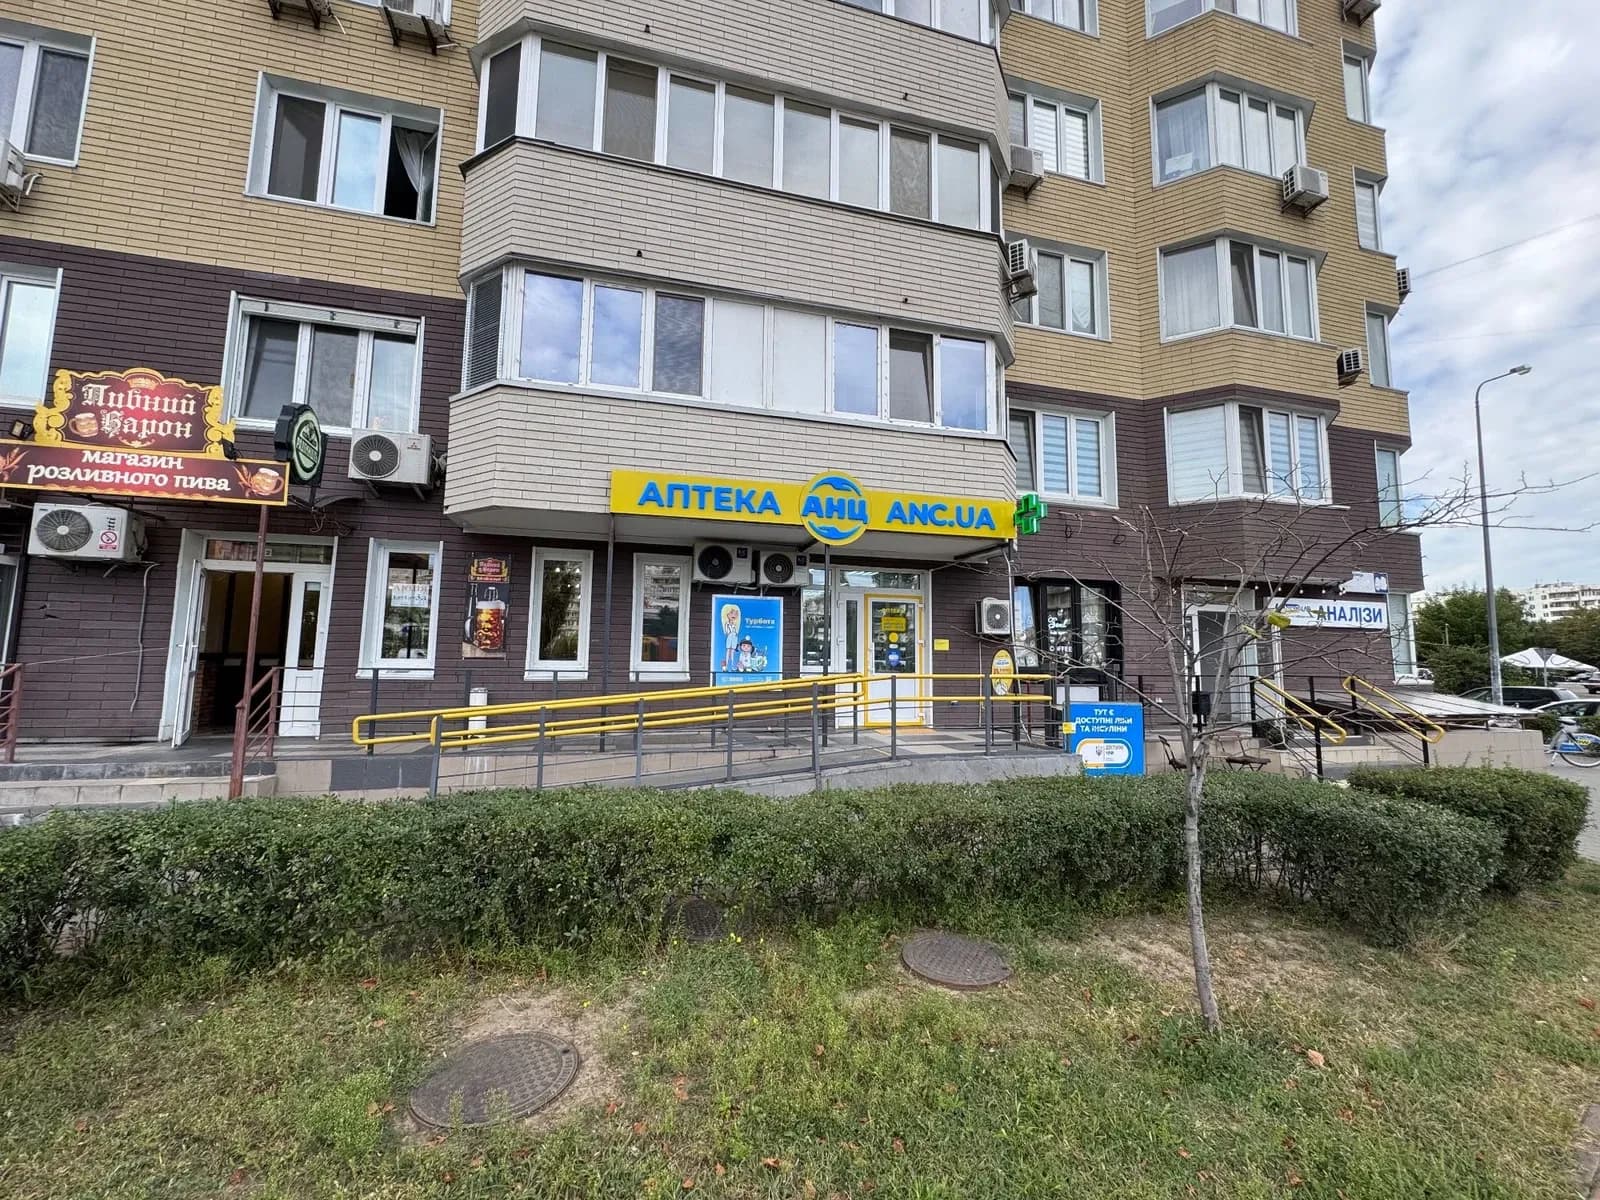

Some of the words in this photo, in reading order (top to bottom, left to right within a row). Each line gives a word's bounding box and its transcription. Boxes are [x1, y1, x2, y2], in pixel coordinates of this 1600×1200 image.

[81, 383, 196, 416] Пивний
[99, 410, 192, 439] Барон
[81, 450, 184, 470] магазин
[27, 464, 169, 487] розливного
[173, 473, 231, 492] пива
[637, 481, 781, 515] АПТЕКА
[801, 495, 869, 524] АНЦ
[886, 501, 996, 530] ANC.UA
[745, 617, 776, 625] Турбота
[1317, 606, 1383, 623] АНАЛІЗИ
[1075, 716, 1113, 725] ДОСТУПНІ
[1094, 708, 1107, 716] ТУТ
[1080, 725, 1091, 733] ТА
